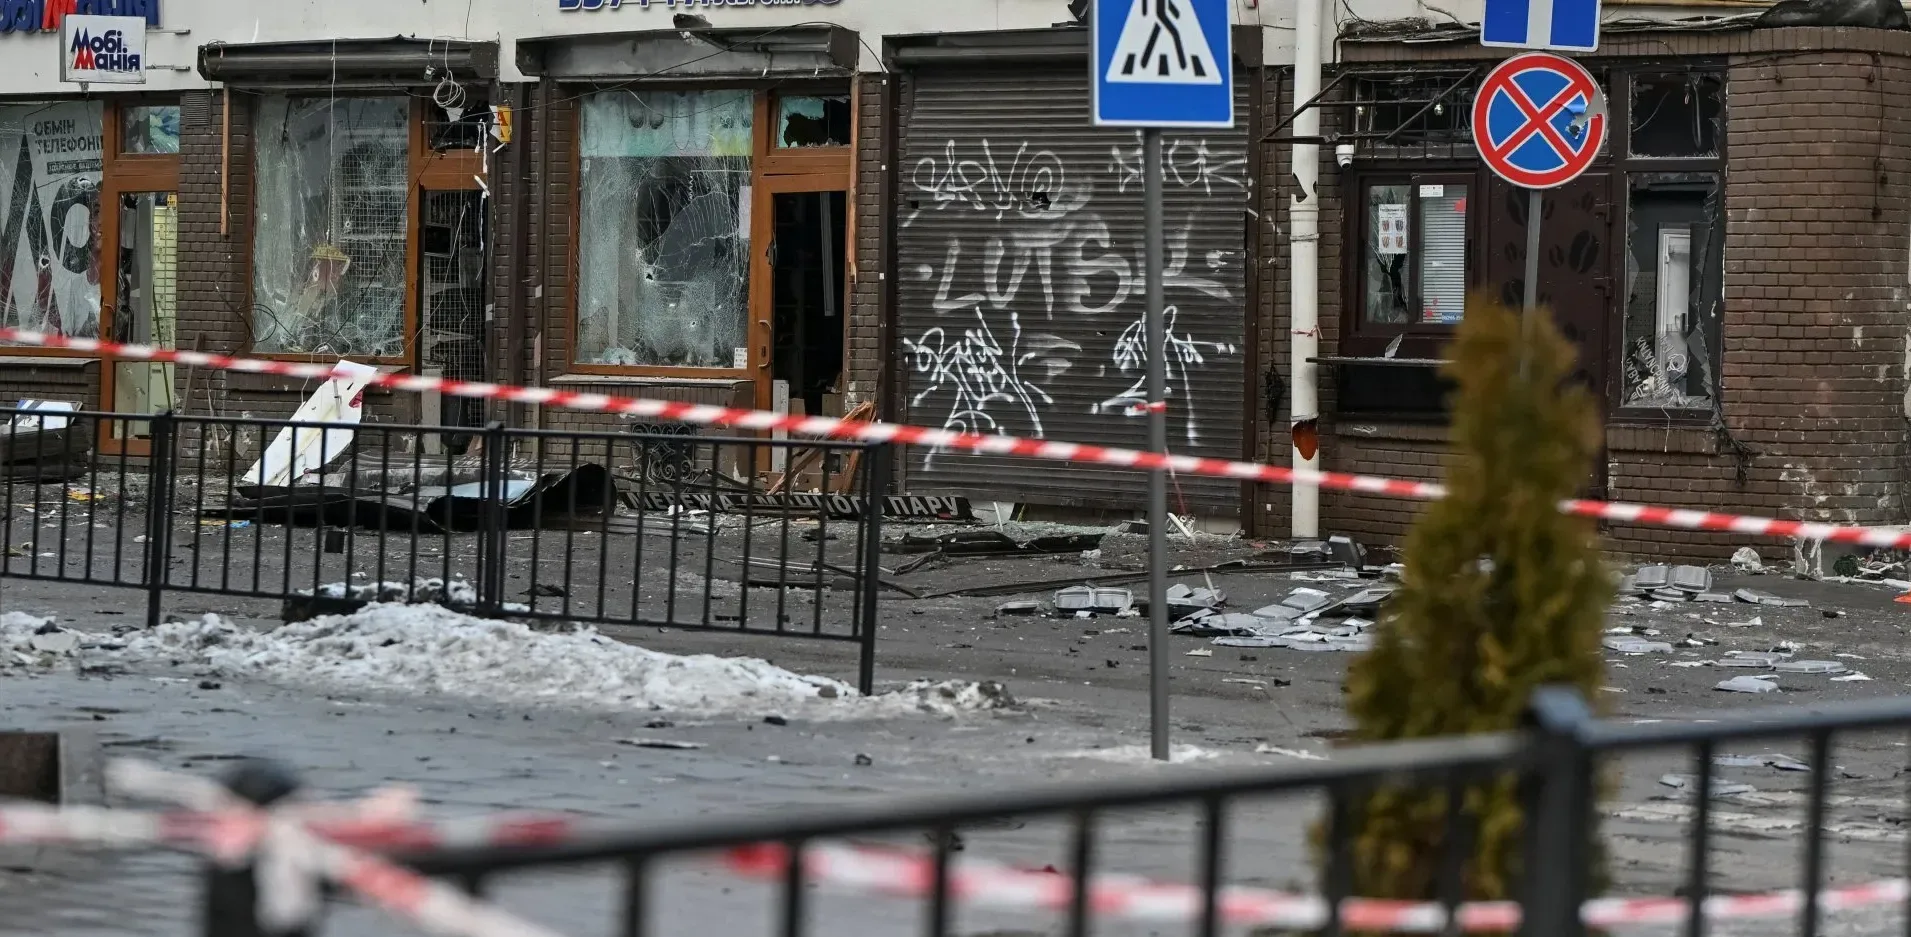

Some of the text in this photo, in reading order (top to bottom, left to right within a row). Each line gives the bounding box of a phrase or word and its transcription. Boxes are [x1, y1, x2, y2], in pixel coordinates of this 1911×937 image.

[70, 26, 122, 54] Мобі
[74, 46, 140, 72] Манія
[33, 118, 76, 136] ОБМІН
[887, 495, 959, 516] ПАРУ
